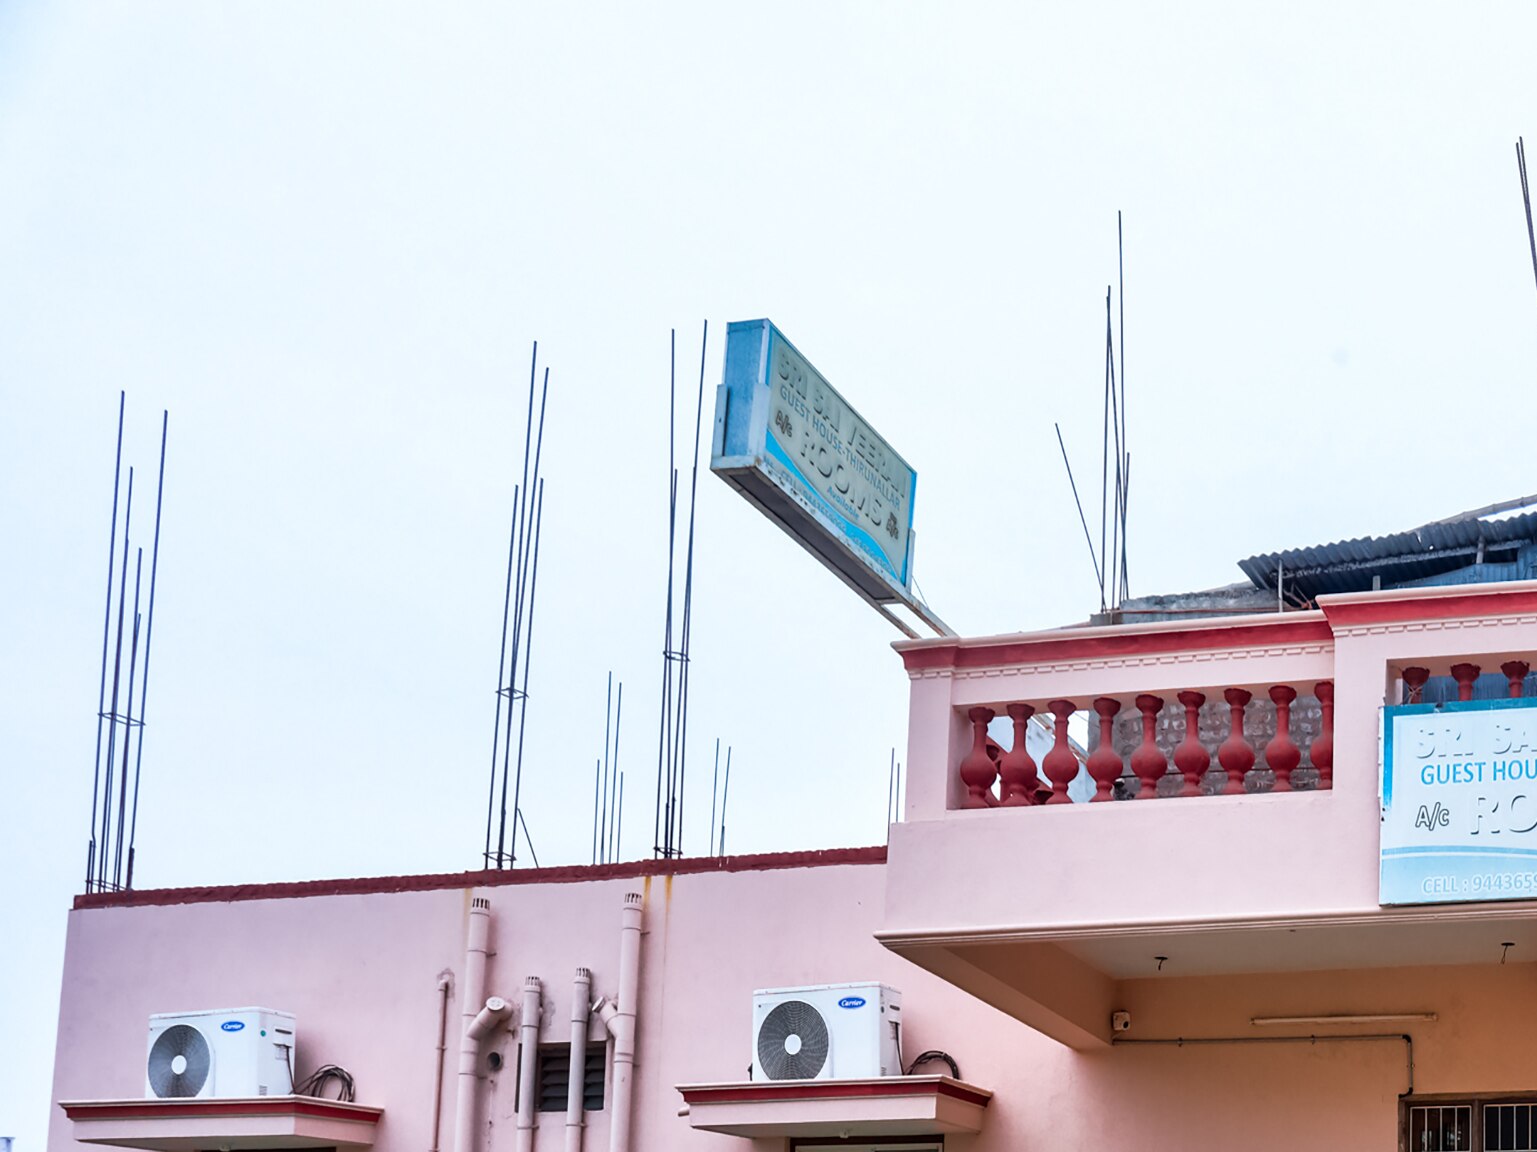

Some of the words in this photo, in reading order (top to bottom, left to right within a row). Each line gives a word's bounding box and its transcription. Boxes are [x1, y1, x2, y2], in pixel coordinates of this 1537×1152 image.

[781, 384, 810, 422] GUEST
[800, 427, 882, 526] ROOMS
[1416, 724, 1474, 759] SRI
[1421, 762, 1486, 786] GUEST
[1415, 802, 1450, 831] A/c
[1423, 878, 1458, 894] CELL
[841, 999, 863, 1007] Carrier
